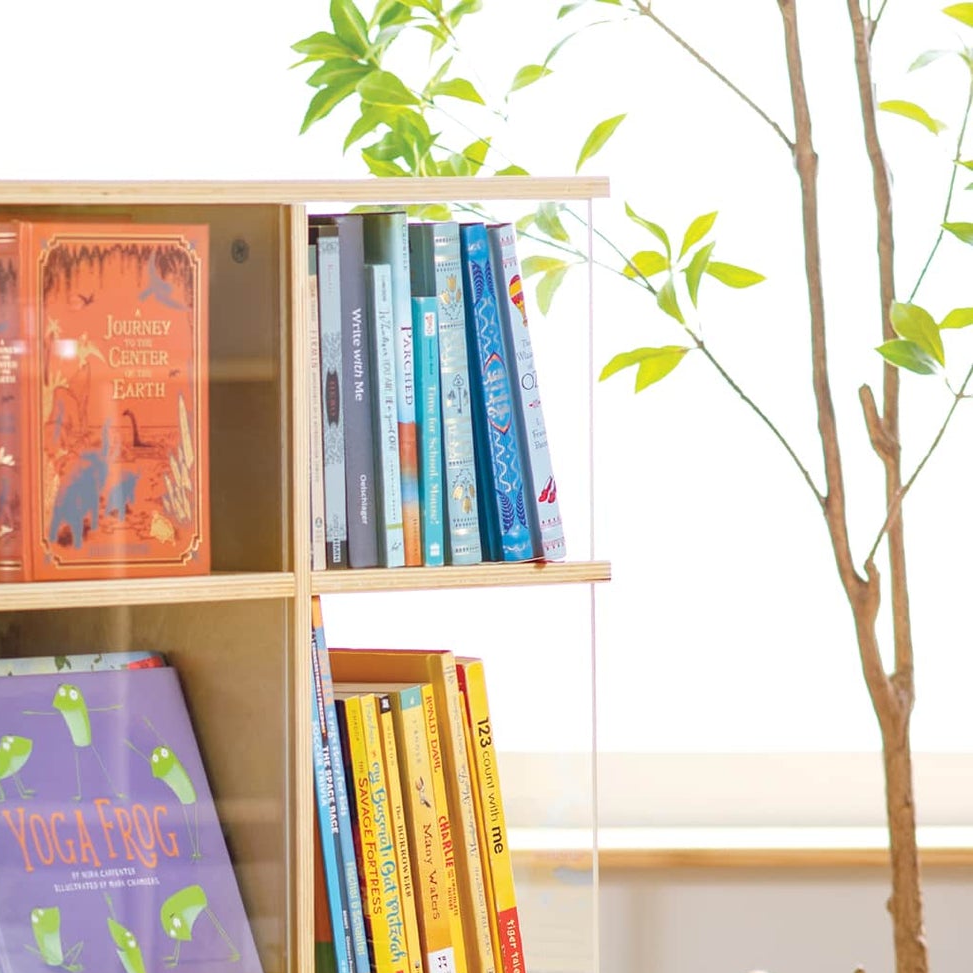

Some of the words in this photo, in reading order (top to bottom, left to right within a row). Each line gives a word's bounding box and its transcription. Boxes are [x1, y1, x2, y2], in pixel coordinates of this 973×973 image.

[103, 314, 171, 340] JOURNEY
[134, 308, 142, 318] A
[352, 308, 363, 347] Write
[108, 346, 169, 368] CENTER
[353, 349, 364, 378] with
[401, 325, 415, 406] PARCHED
[112, 378, 166, 400] EARTH
[354, 381, 365, 402] Me
[427, 384, 438, 415] Time
[428, 417, 438, 434] for
[425, 695, 436, 735] ROALD
[477, 716, 492, 749] 123
[323, 746, 332, 769] THE
[430, 738, 442, 773] DAHL
[482, 750, 495, 790] count
[326, 770, 336, 802] SPACE
[368, 761, 382, 785] my
[329, 804, 339, 835] RACE
[371, 787, 393, 857] Basmati
[487, 793, 500, 823] with
[2, 807, 102, 873] YOGA
[94, 797, 180, 869] FROG
[358, 777, 373, 838] SAVAGE
[366, 842, 383, 915] FORTRESS
[422, 823, 435, 865] Many
[438, 815, 454, 868] CHARLIE
[491, 826, 505, 855] me
[381, 860, 399, 893] Bat
[397, 825, 412, 898] BORROWERS
[428, 870, 442, 921] Waters
[385, 896, 407, 963] Mitzvah
[505, 919, 518, 949] tiger
